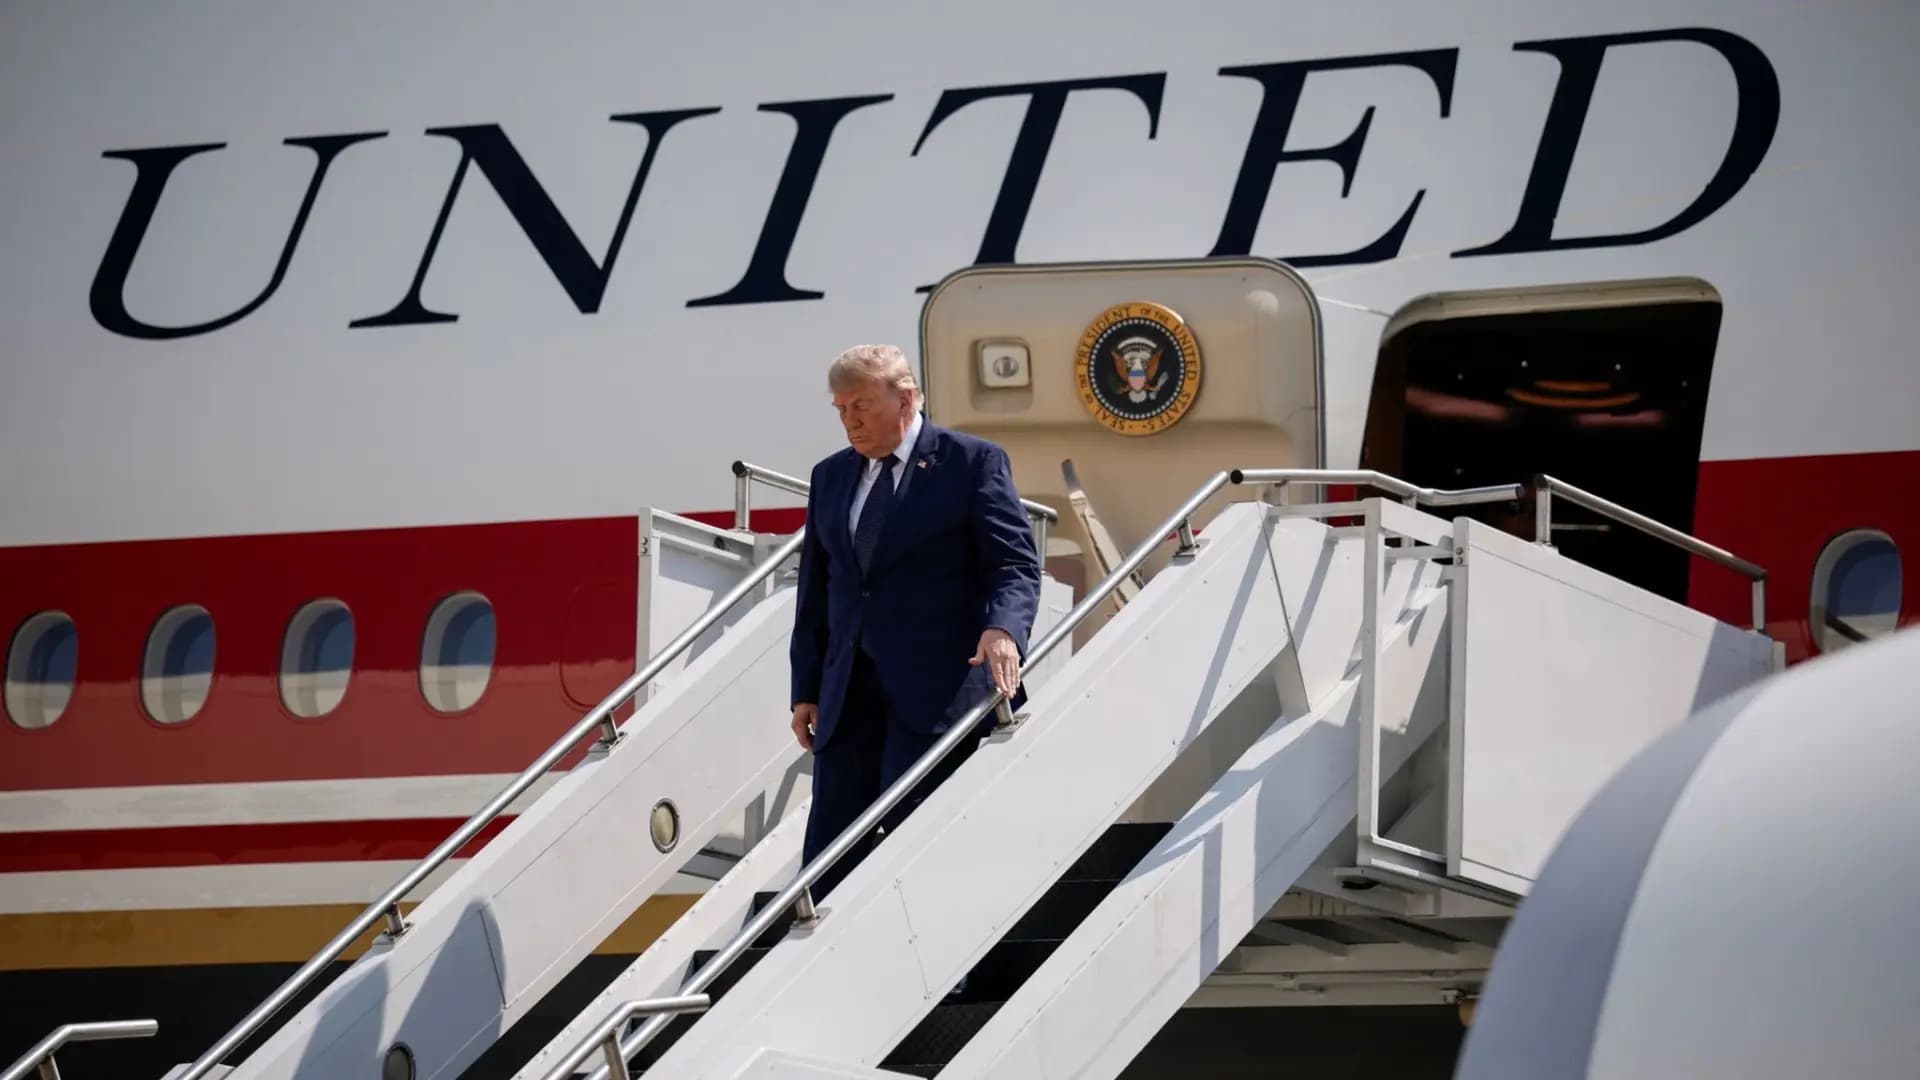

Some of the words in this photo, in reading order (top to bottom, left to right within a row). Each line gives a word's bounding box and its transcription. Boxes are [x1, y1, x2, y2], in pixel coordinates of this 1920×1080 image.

[89, 27, 1780, 340] UNITED
[1078, 306, 1131, 366] PRESIDENT
[1173, 324, 1198, 381] UNITED
[1095, 409, 1126, 431] SEAL
[1146, 392, 1191, 431] STATES
